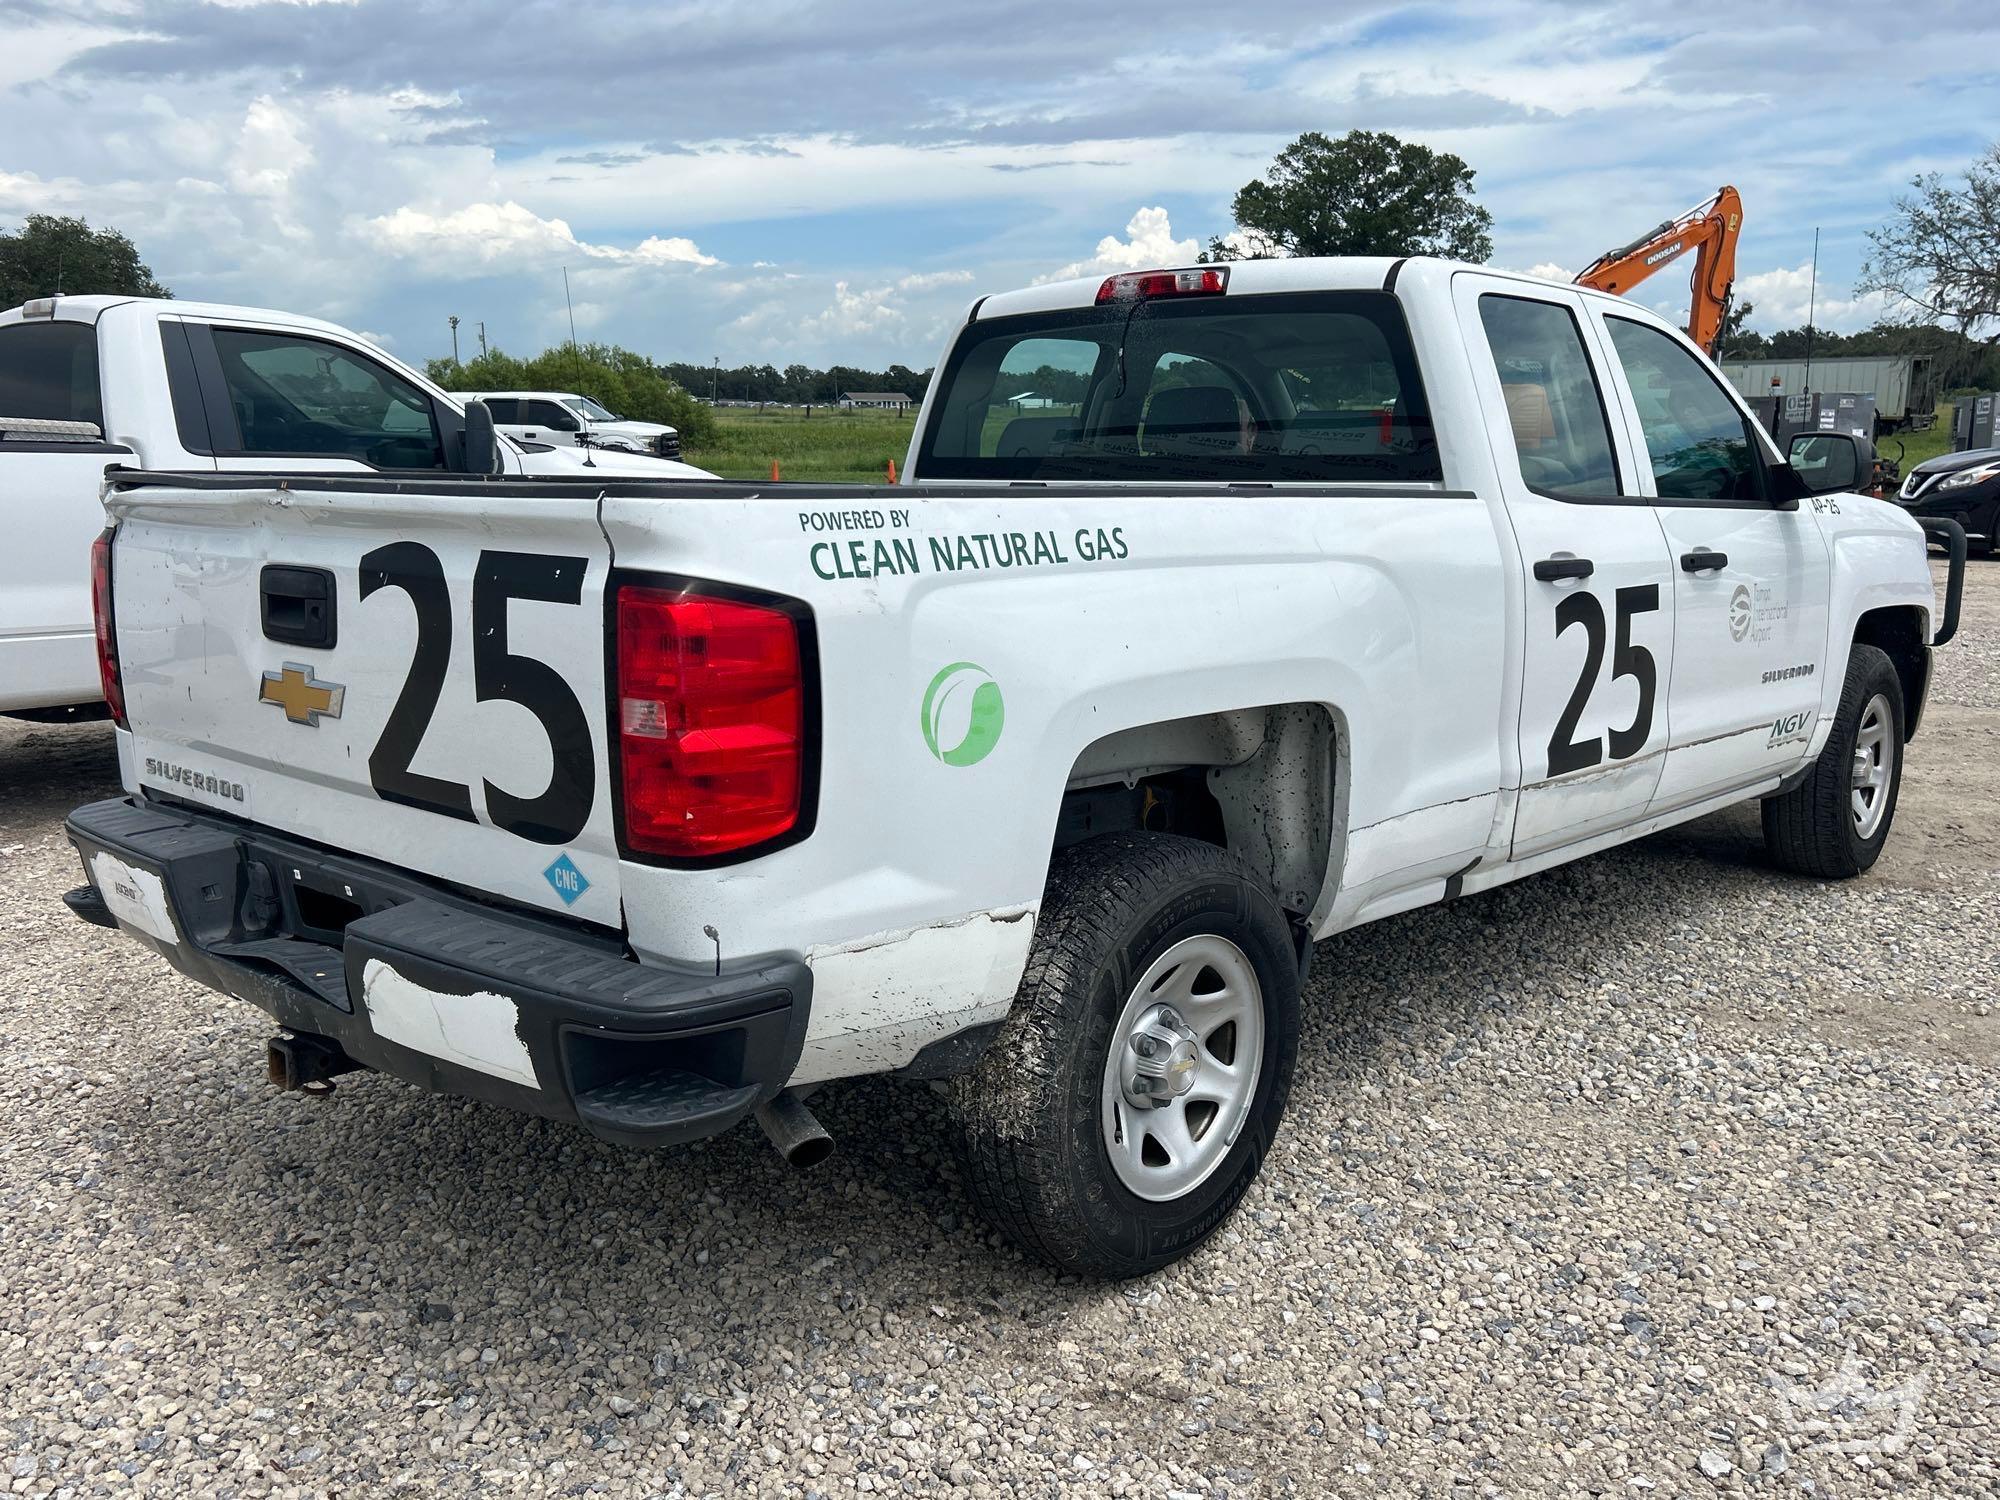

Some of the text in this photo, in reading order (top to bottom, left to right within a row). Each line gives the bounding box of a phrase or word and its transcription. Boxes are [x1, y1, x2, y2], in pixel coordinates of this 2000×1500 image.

[1647, 242, 1681, 266] DOOSAN
[1811, 498, 1841, 515] AP-25
[798, 509, 910, 533] POWERED BY
[810, 527, 1129, 581] CLEAN NATURAL GAS
[1546, 583, 1660, 779] 25
[1761, 663, 1815, 685] SILVERADO
[358, 541, 595, 846] 25
[1770, 710, 1812, 738] NGV
[144, 757, 245, 803] SILVERADO
[553, 866, 579, 894] CNG
